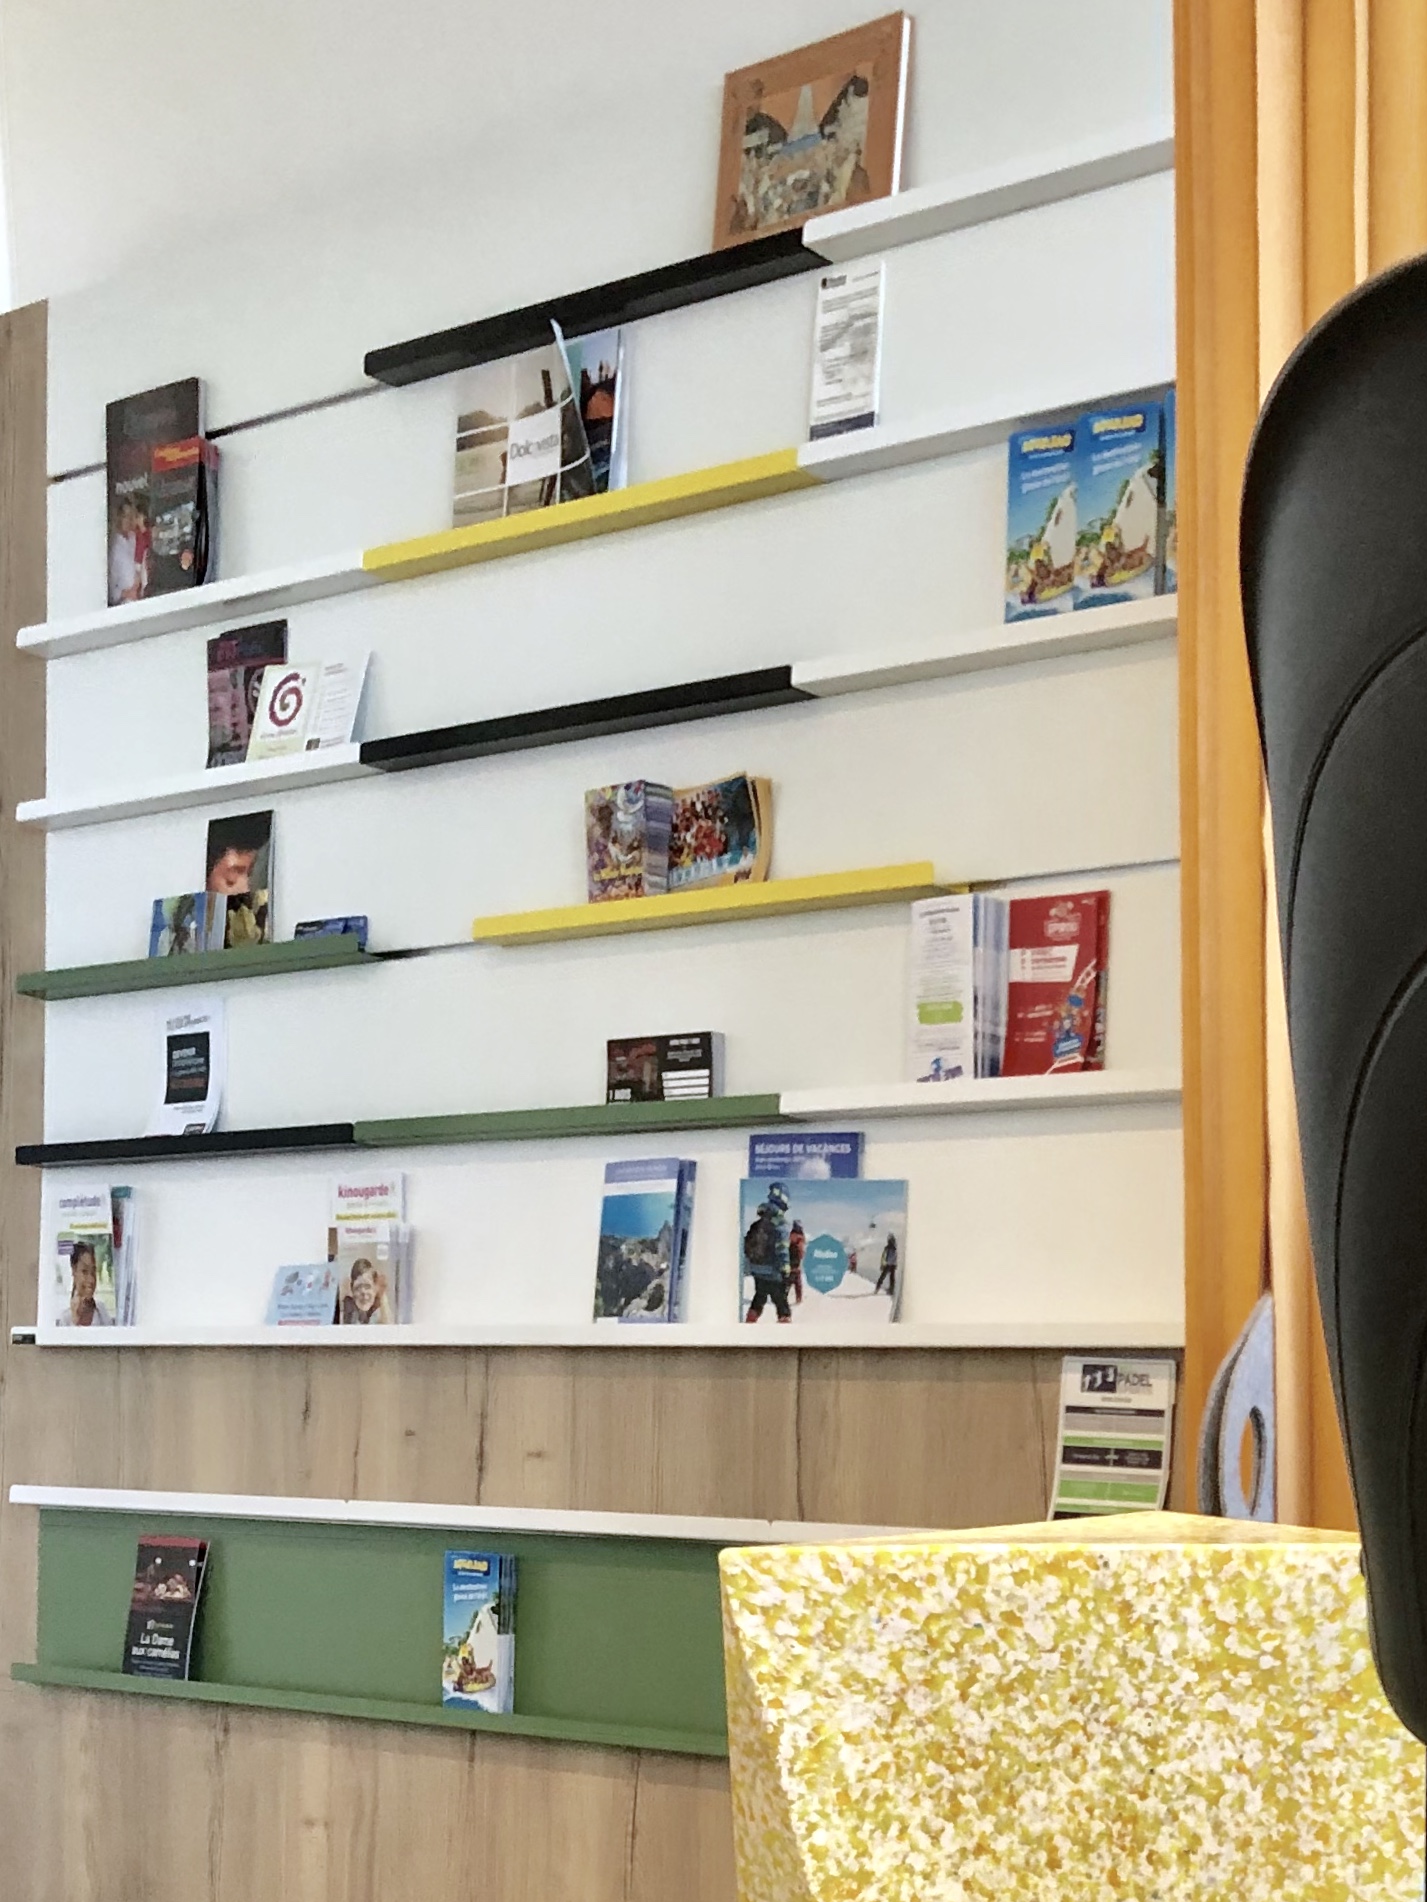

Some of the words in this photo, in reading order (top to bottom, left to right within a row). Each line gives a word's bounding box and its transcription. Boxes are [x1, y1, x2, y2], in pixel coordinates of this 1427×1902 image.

[754, 1142, 790, 1154] SÉJOURS
[793, 1142, 804, 1154] DE
[806, 1142, 852, 1155] VACANCES
[338, 1183, 389, 1199] kinougarde
[1117, 1372, 1153, 1388] PADEL
[140, 1632, 150, 1645] La
[152, 1633, 174, 1646] Dame
[131, 1646, 146, 1656] aux
